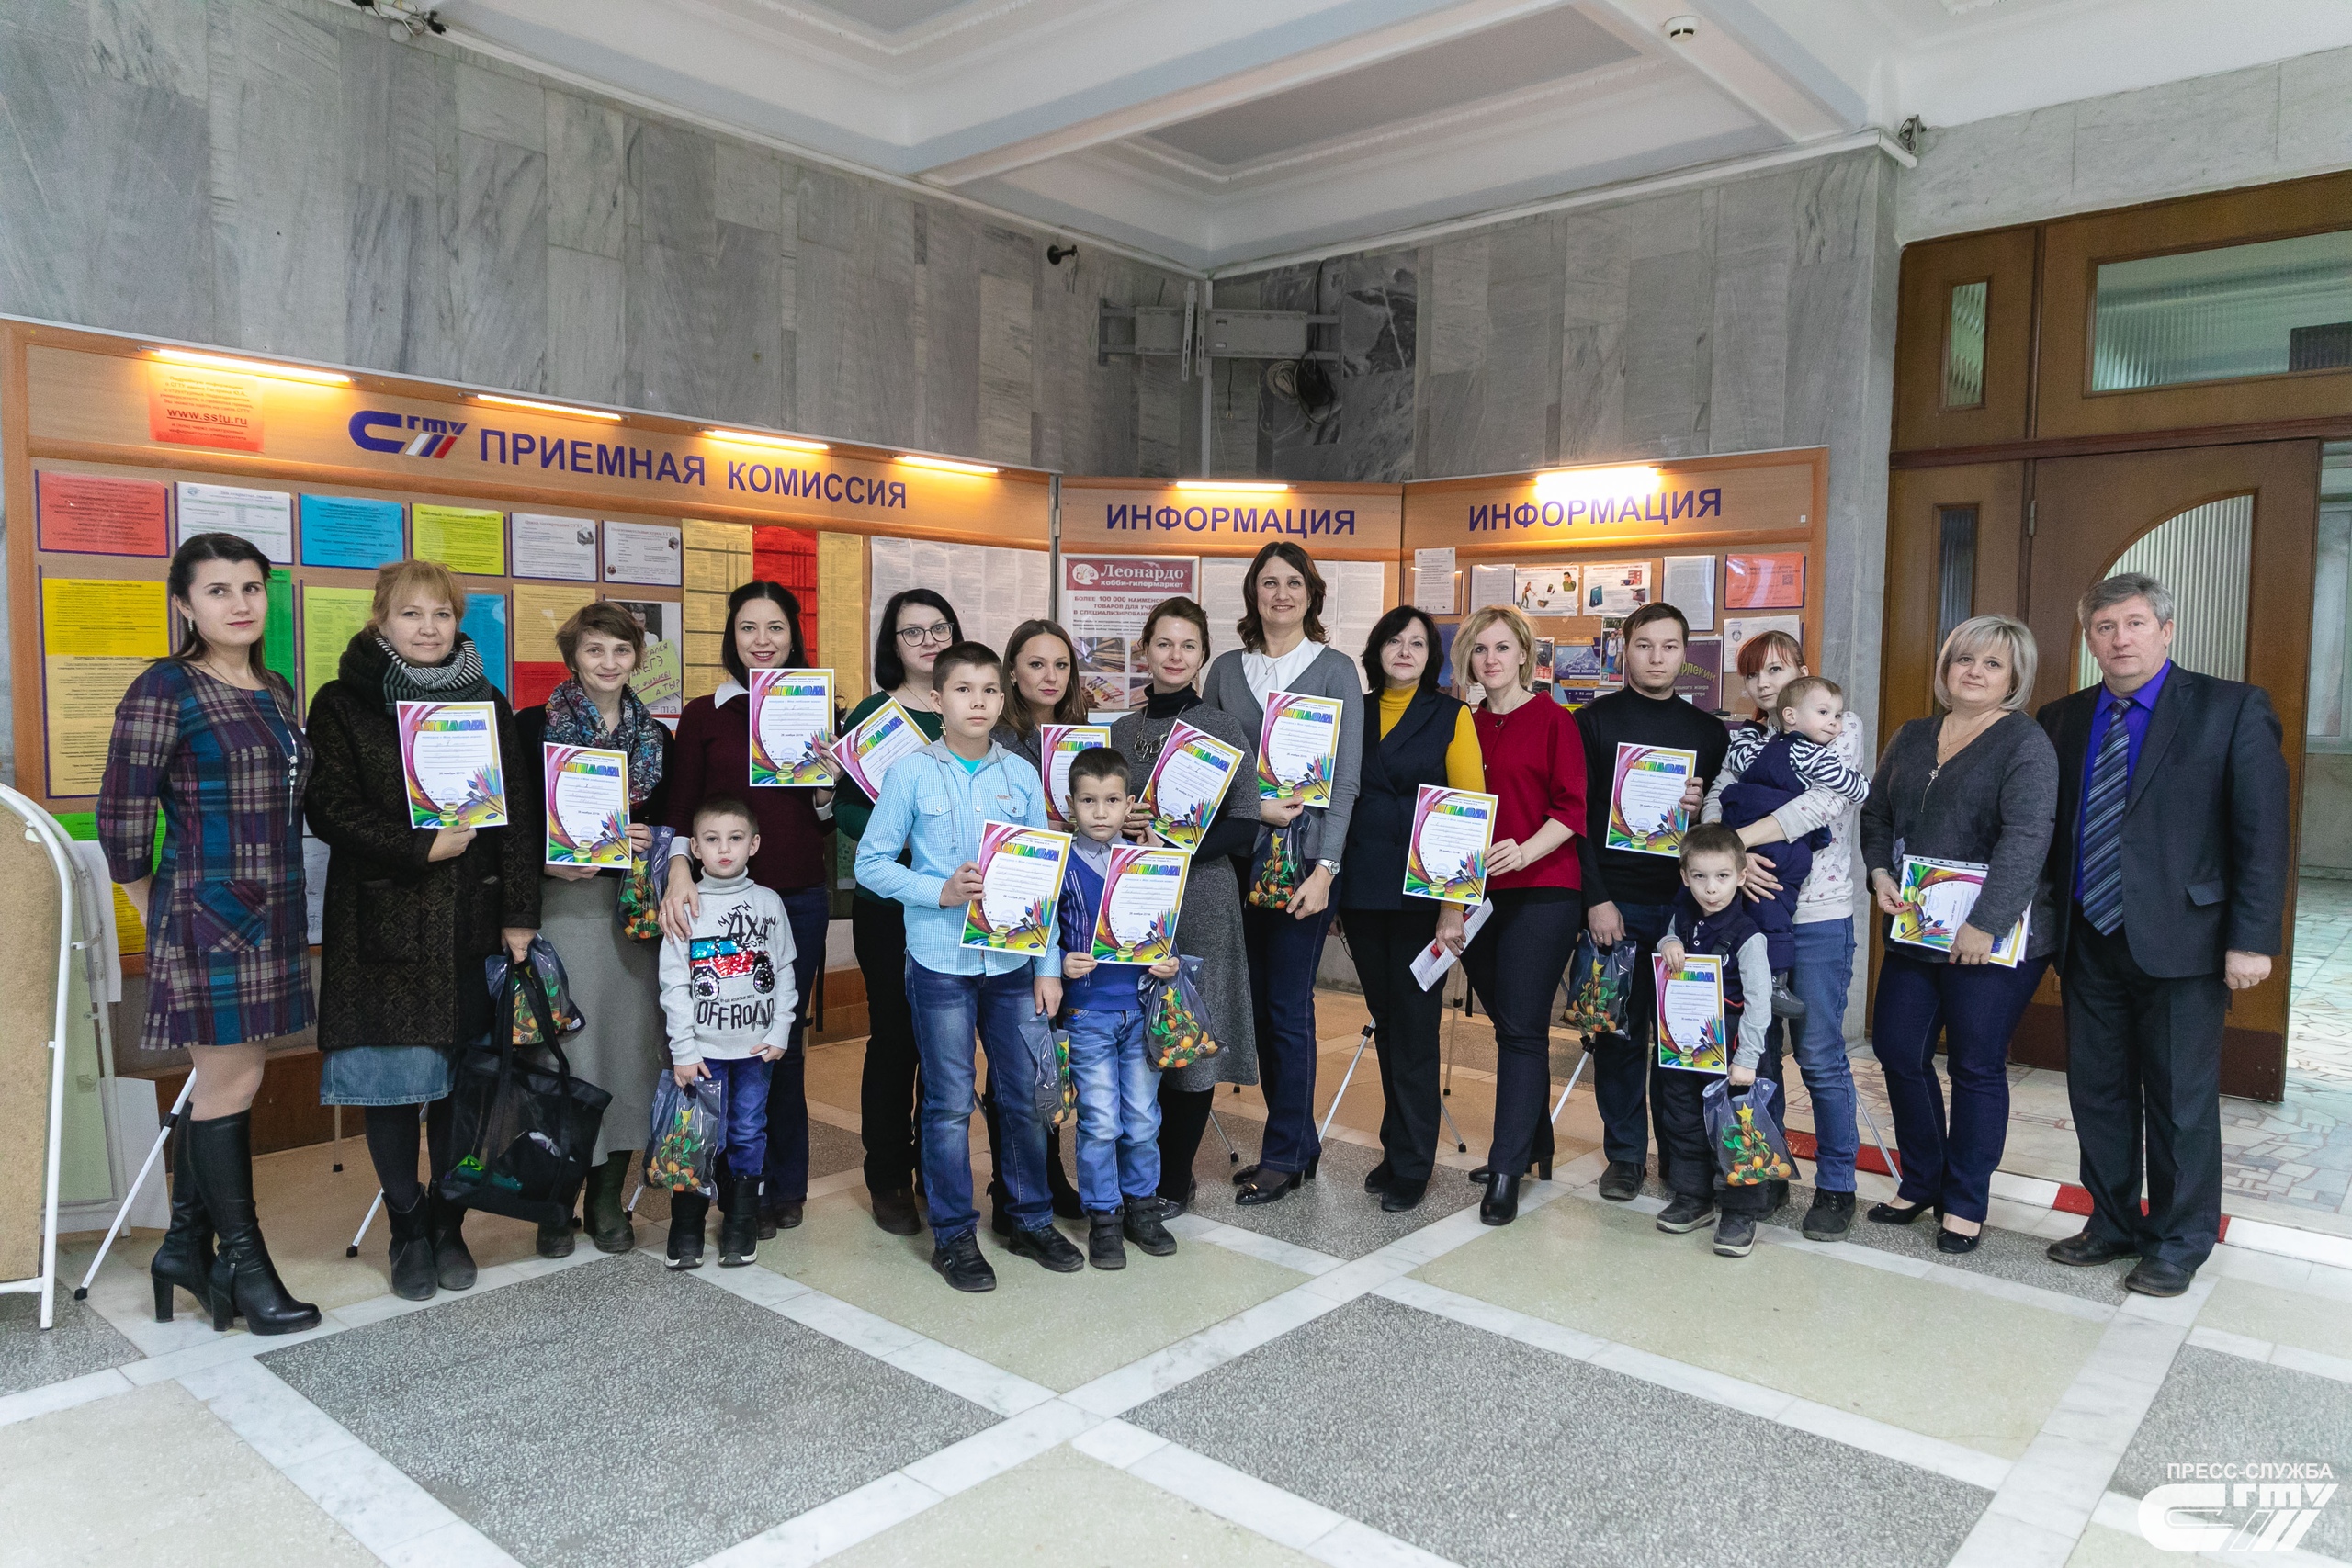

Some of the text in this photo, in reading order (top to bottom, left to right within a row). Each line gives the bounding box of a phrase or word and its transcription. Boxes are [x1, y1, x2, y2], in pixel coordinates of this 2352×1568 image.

[167, 409, 248, 425] www.sstu.ru
[480, 428, 706, 486] ПРИЕМНАЯ
[728, 460, 907, 509] КОМИССИЯ
[1469, 488, 1721, 531] ИНФОРМАЦИЯ
[1107, 504, 1355, 539] ИНФОРМАЦИЯ
[1101, 564, 1184, 581] Леонардо
[1101, 579, 1184, 588] хобби-гипермаркет
[642, 655, 663, 673] ЕГЭ
[663, 679, 680, 690] ТЫ?
[760, 684, 825, 696] ДИПЛОМ
[1274, 708, 1333, 724] ДИПЛОМ
[410, 719, 487, 731] ДИПЛОМ
[851, 715, 904, 763] ДИПЛОМ
[1176, 740, 1230, 772] ДИПЛОМ
[557, 761, 620, 777] ДИПЛОМ
[1626, 760, 1686, 775] ДИПЛОМ
[1426, 802, 1487, 819] ДИПЛОМ
[992, 841, 1060, 861] ДИПЛОМ
[1118, 863, 1180, 876] ДИПЛОМ
[717, 900, 752, 927] MATH
[696, 998, 775, 1031] OFFROAD
